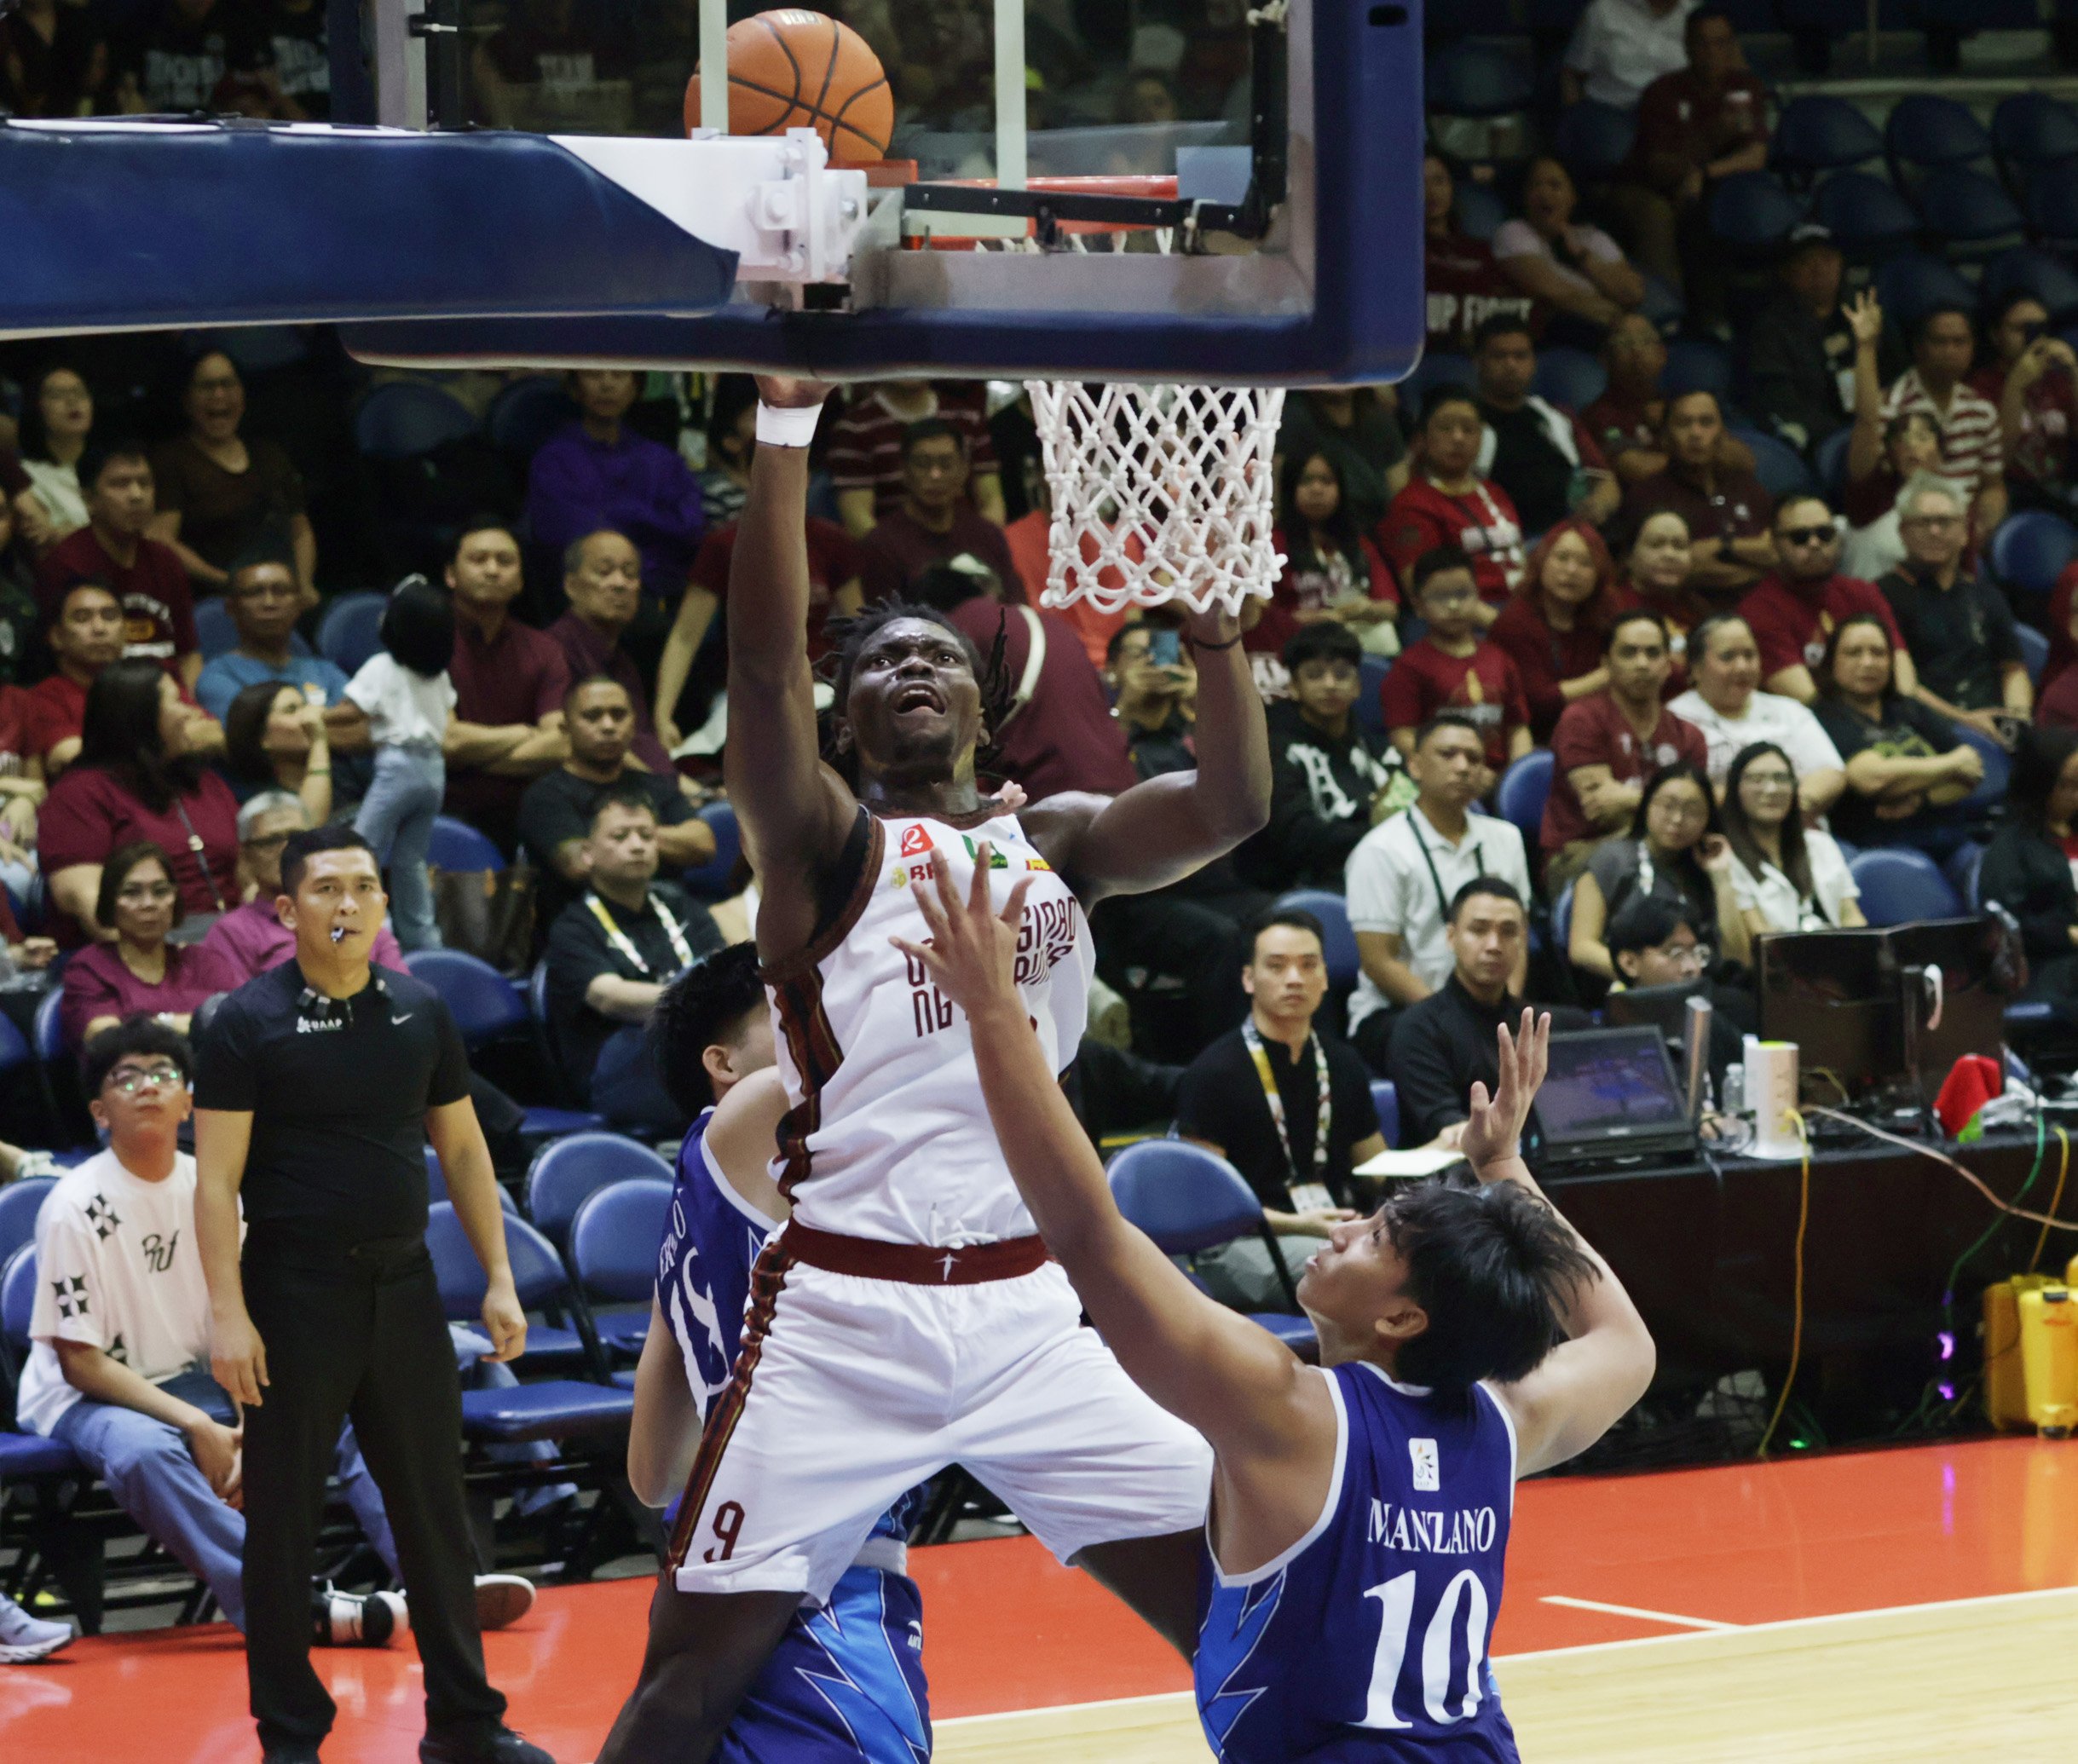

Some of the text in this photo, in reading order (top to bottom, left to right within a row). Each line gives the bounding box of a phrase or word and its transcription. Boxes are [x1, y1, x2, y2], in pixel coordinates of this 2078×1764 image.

[703, 1501, 745, 1564] 9
[1367, 1497, 1496, 1554] MANZANO
[1347, 1569, 1488, 1729] 10
